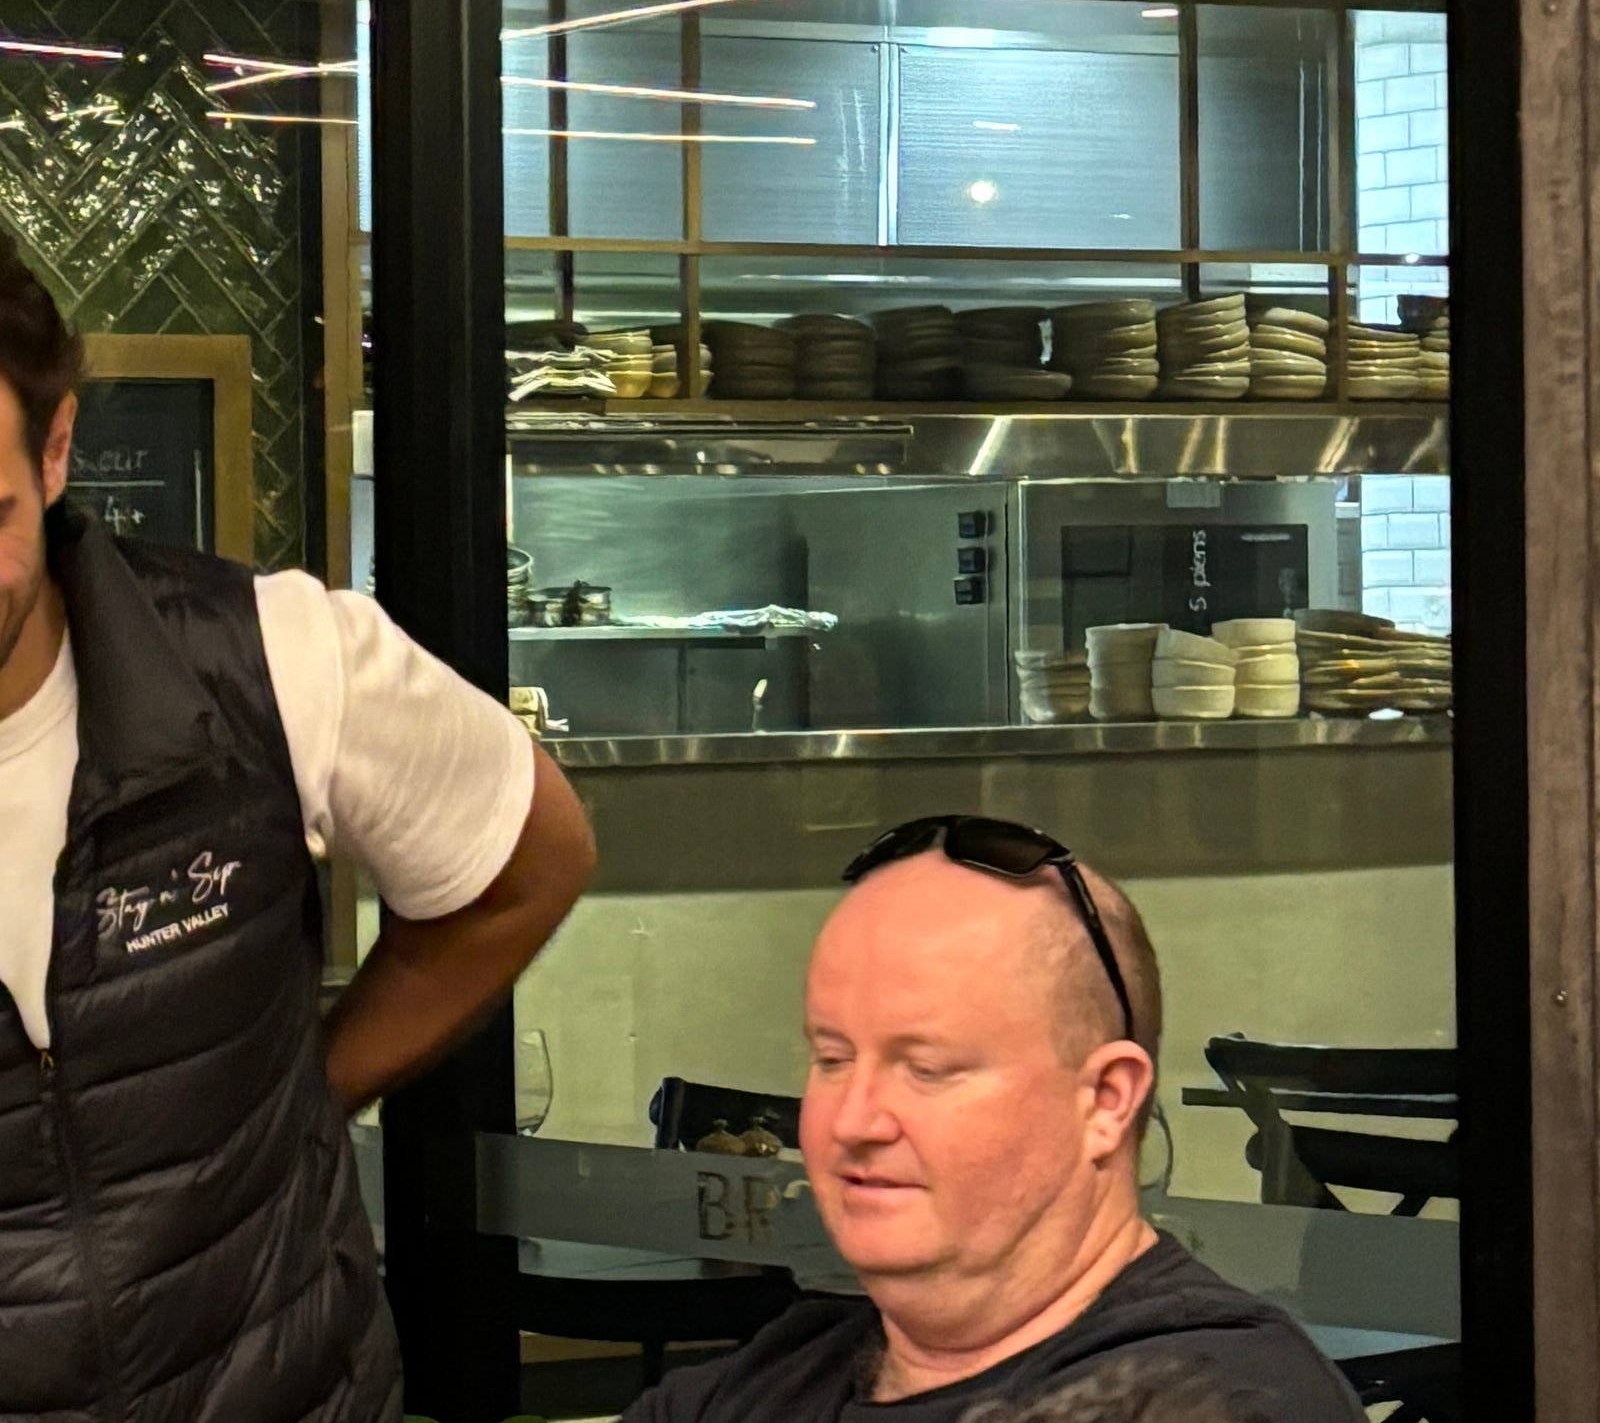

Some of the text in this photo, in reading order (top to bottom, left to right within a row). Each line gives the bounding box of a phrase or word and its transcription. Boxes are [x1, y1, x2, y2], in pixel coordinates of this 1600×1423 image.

[96, 886, 151, 939] Stay
[187, 850, 243, 905] Sip
[126, 901, 229, 954] HUNTER VALLEY
